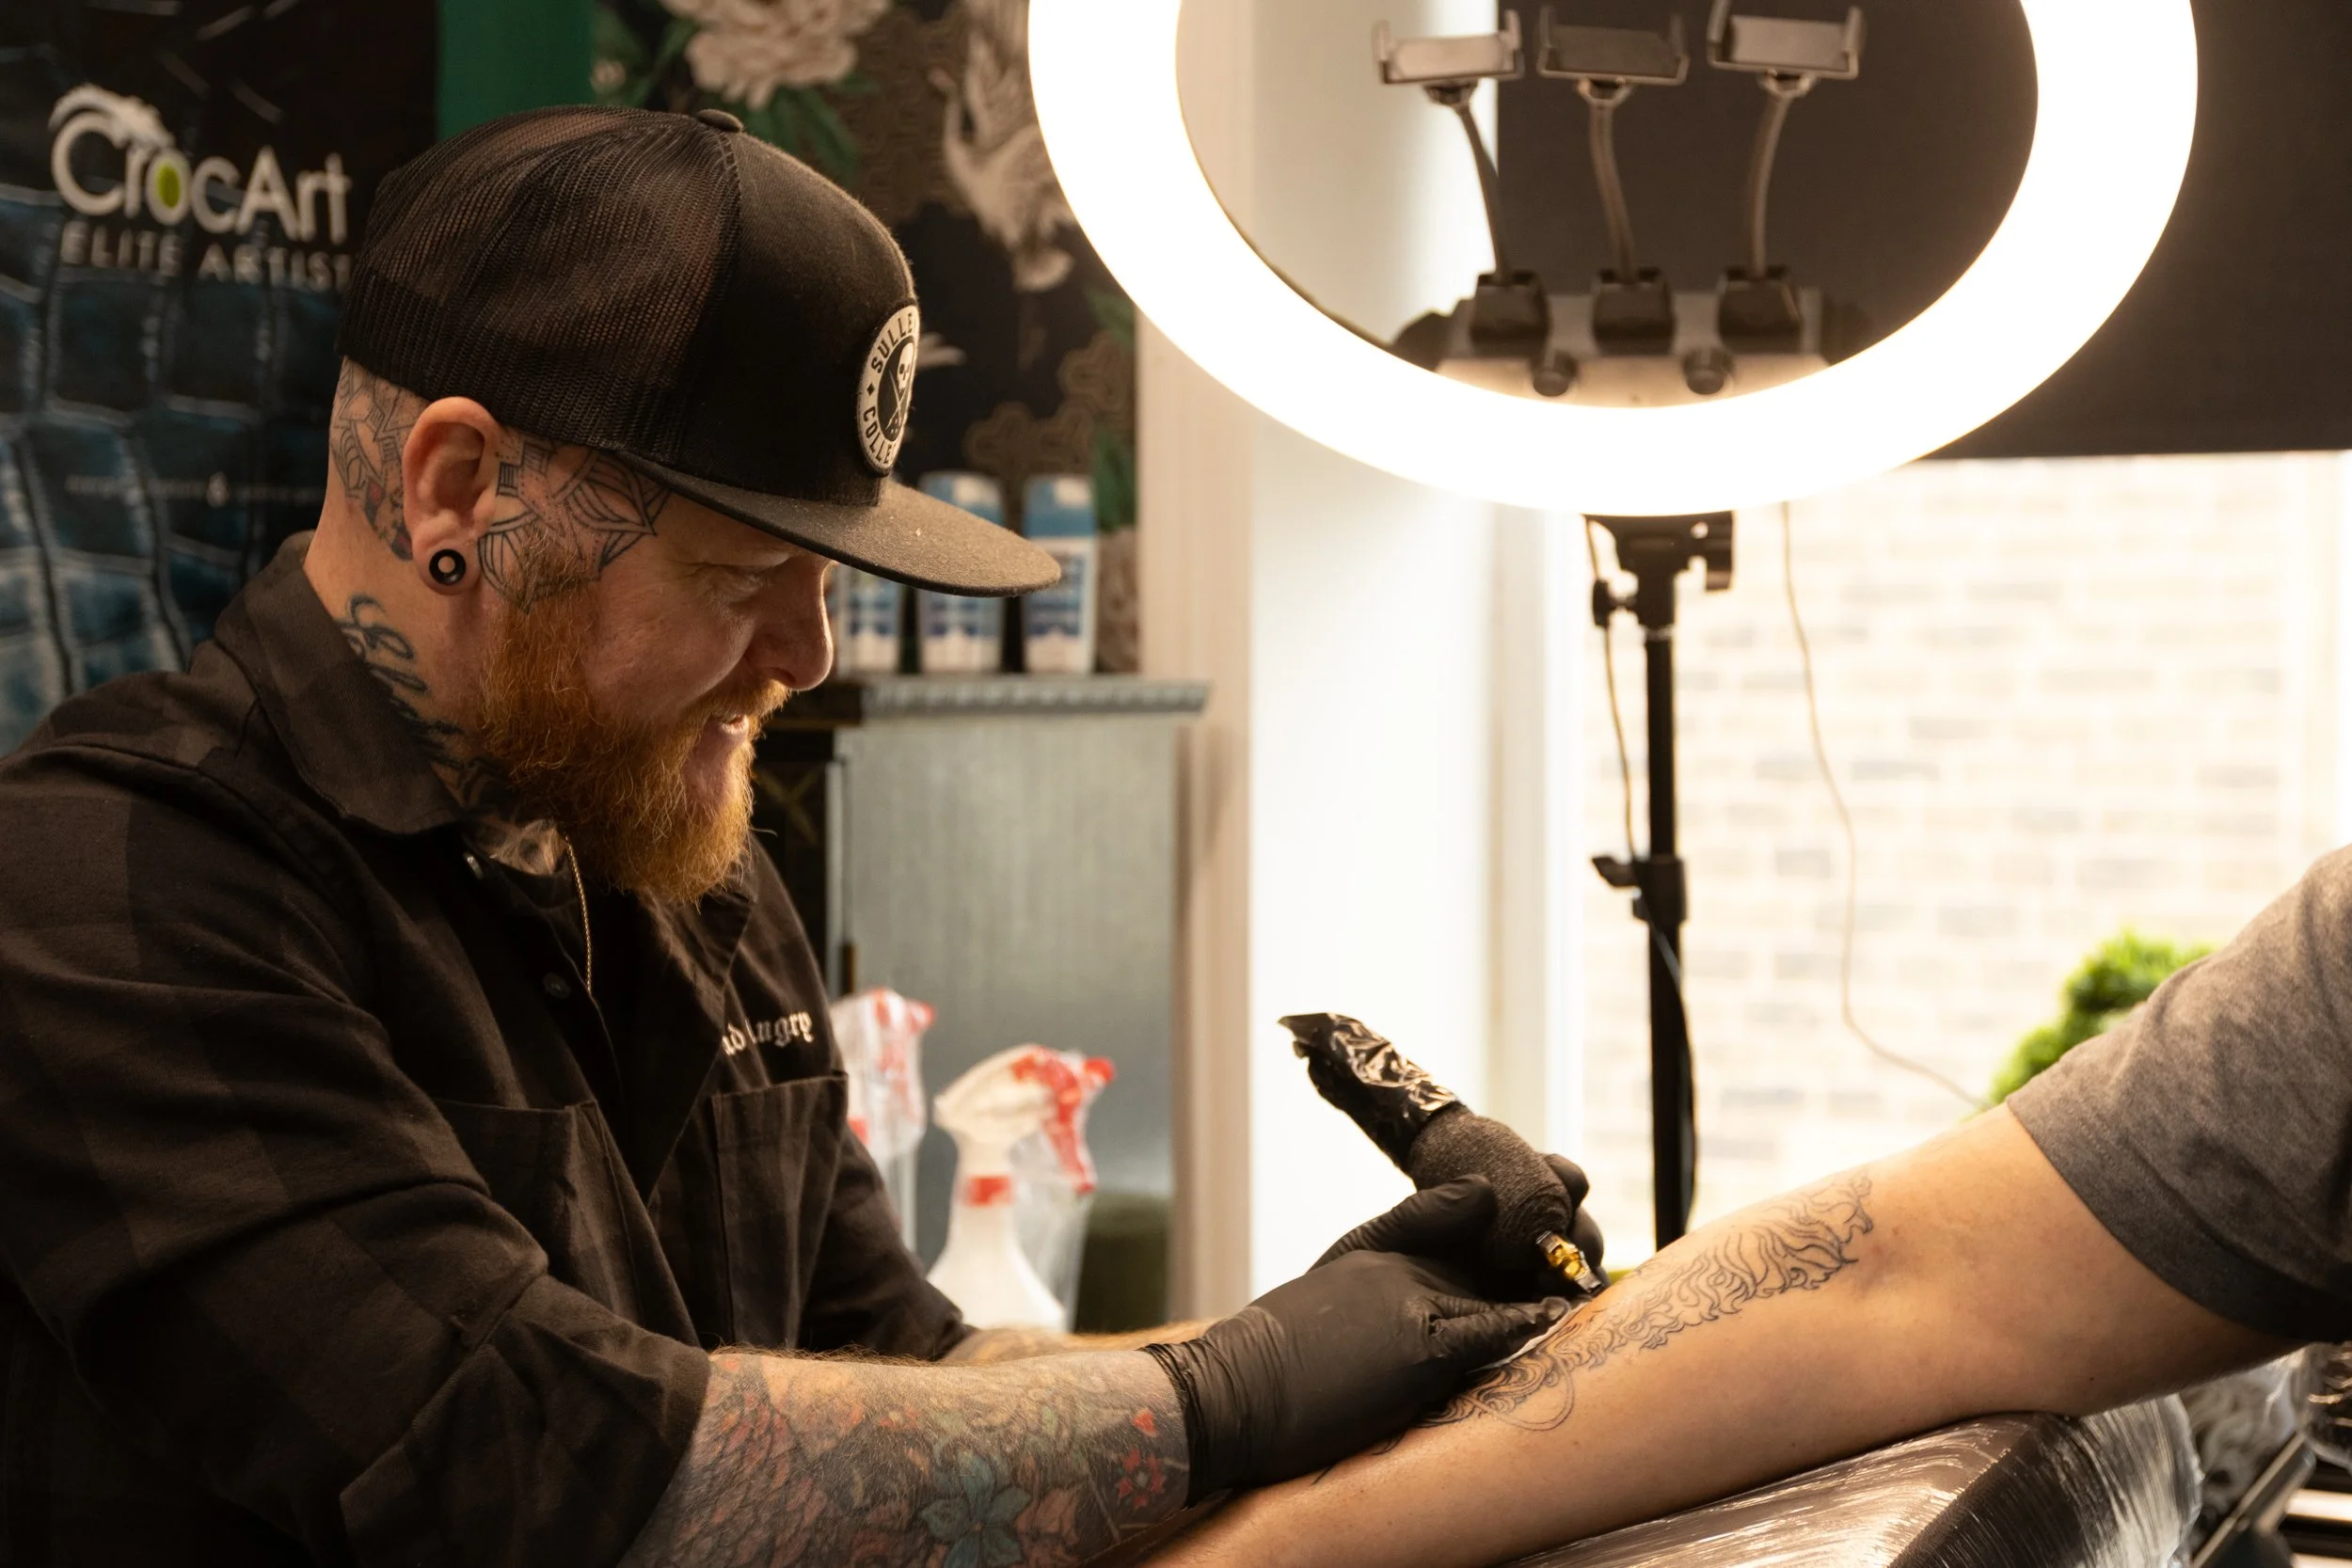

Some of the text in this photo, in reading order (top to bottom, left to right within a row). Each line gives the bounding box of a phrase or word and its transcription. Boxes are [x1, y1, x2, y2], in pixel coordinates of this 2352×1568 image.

[51, 109, 352, 245] CrocArt
[60, 221, 184, 279] ELITE
[870, 312, 914, 374] SULLE
[863, 405, 896, 465] COLLE
